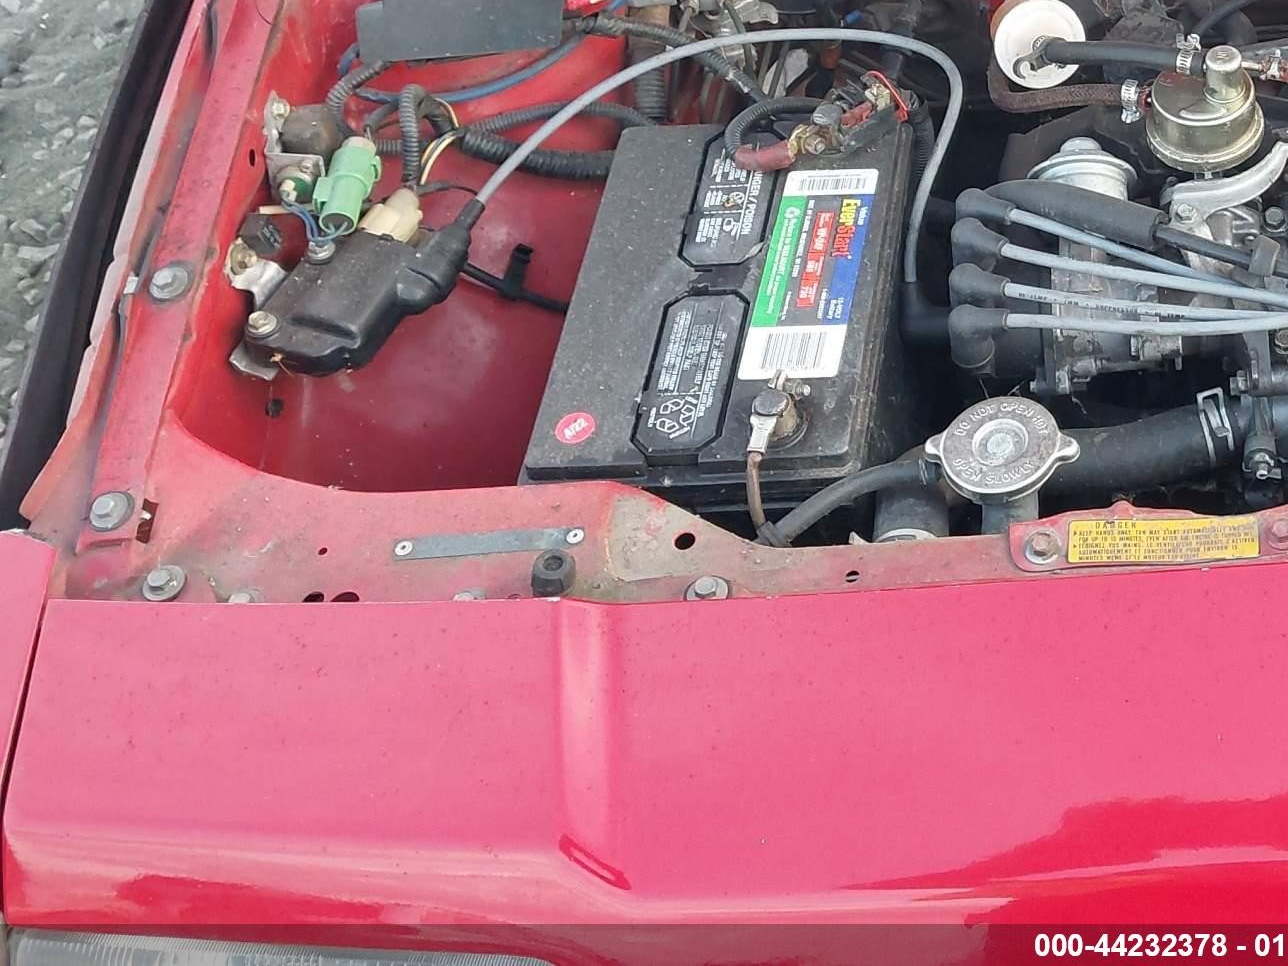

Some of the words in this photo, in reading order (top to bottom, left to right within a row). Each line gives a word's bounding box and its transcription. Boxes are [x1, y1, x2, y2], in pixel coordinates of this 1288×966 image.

[740, 203, 757, 235] POISON
[832, 198, 862, 257] EverStart
[857, 206, 868, 226] Value
[826, 299, 837, 320] Battery
[954, 420, 971, 435] DO
[969, 404, 995, 421] NOT
[1000, 402, 1035, 417] OPEN
[1031, 415, 1049, 434] HOT
[953, 458, 982, 482] OPEN
[985, 459, 1034, 484] SLOWLY
